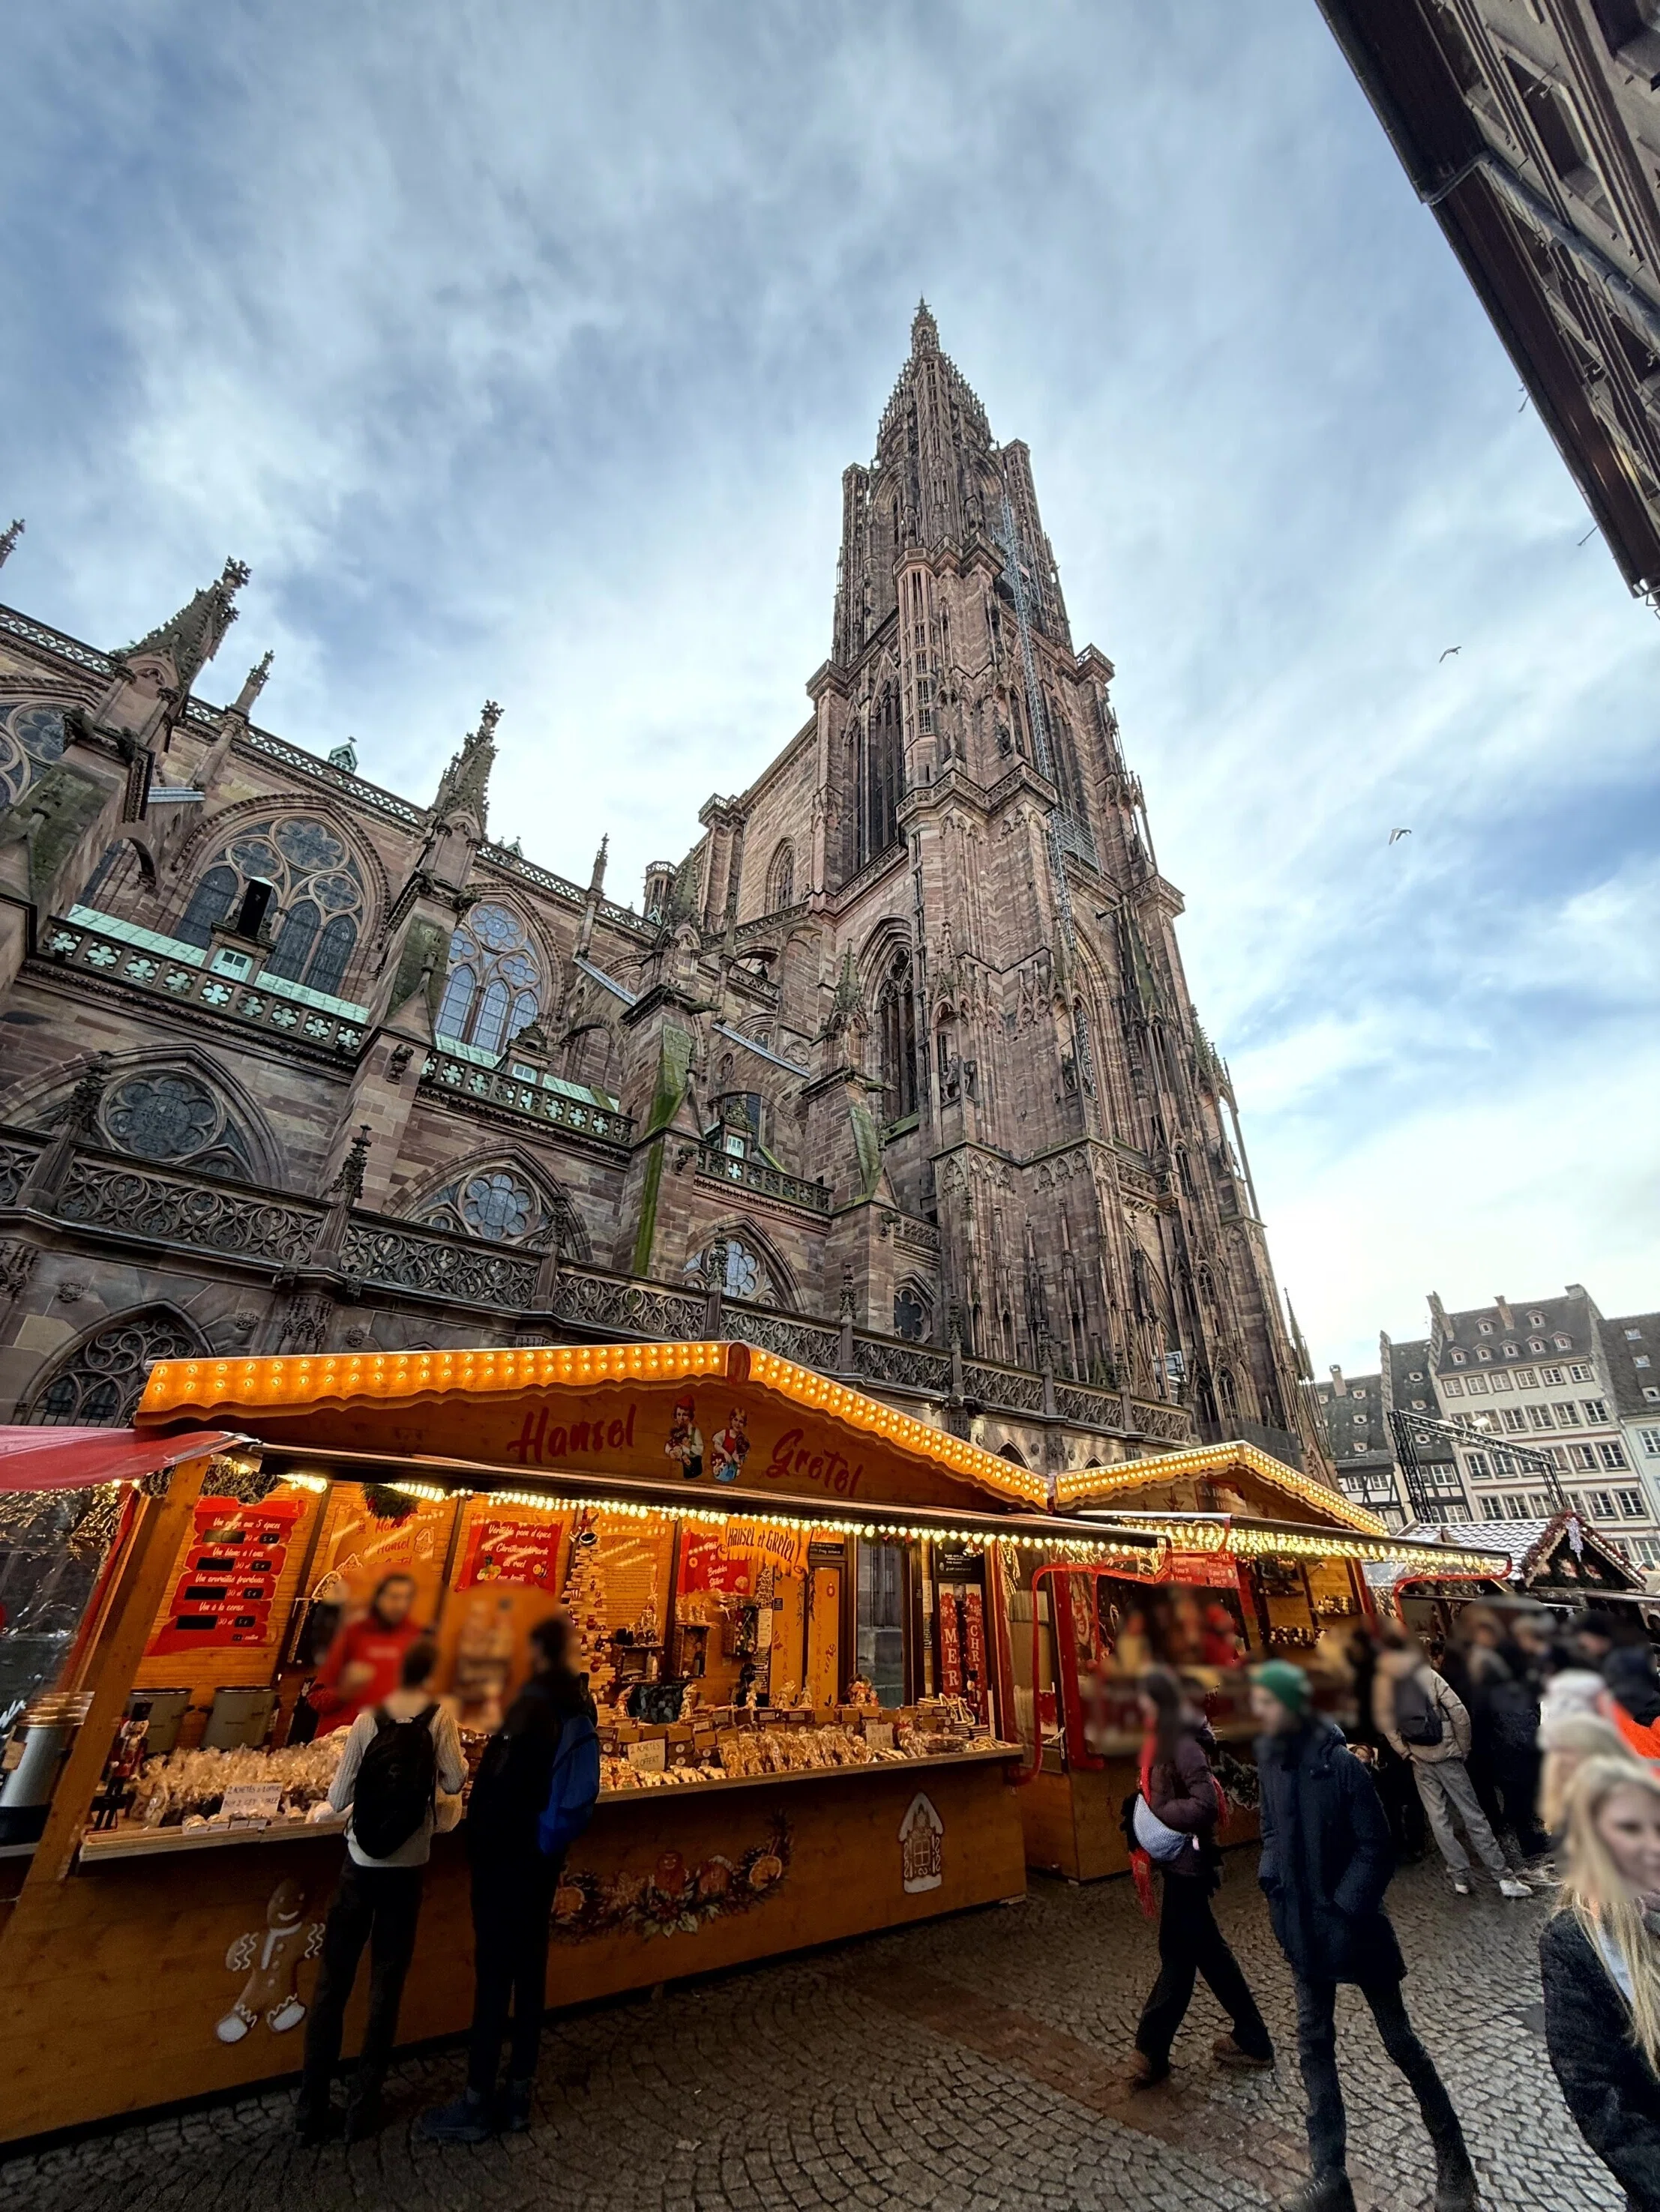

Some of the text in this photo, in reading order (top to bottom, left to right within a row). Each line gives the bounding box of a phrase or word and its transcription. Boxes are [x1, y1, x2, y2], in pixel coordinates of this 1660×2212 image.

[507, 1404, 864, 1497] Hansel Gretel
[256, 1519, 263, 1528] 5
